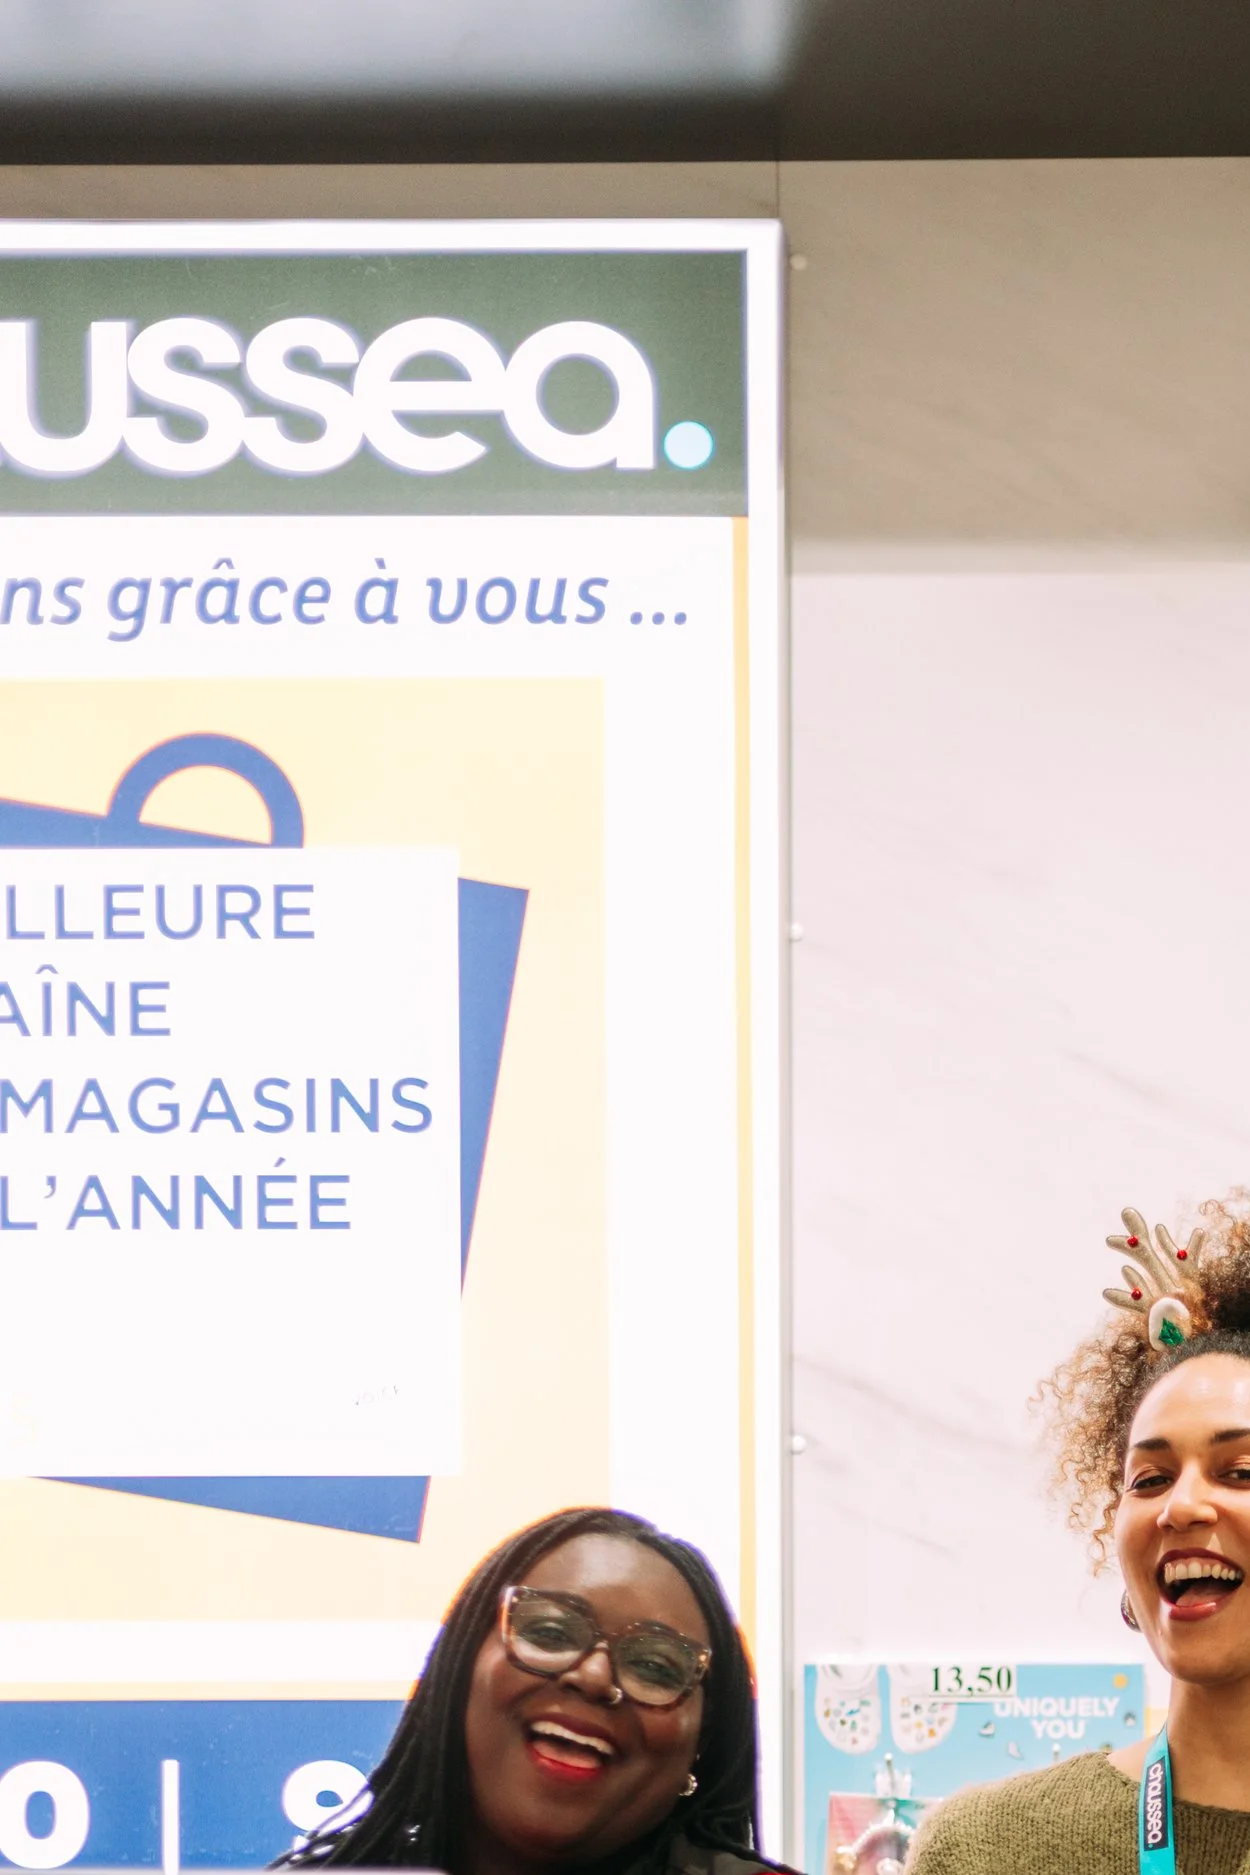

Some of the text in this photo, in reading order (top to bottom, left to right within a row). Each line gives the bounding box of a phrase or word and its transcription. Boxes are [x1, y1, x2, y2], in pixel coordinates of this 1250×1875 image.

[0, 577, 86, 627] ns
[107, 557, 333, 644] grâce
[354, 557, 400, 626] à
[427, 576, 610, 627] vous
[6, 884, 316, 941] LLEURE
[0, 1077, 434, 1136] MAGASINS
[932, 1665, 1013, 1697] 13,50
[993, 1697, 1121, 1718] UNIQUELY
[1030, 1719, 1087, 1740] YOU
